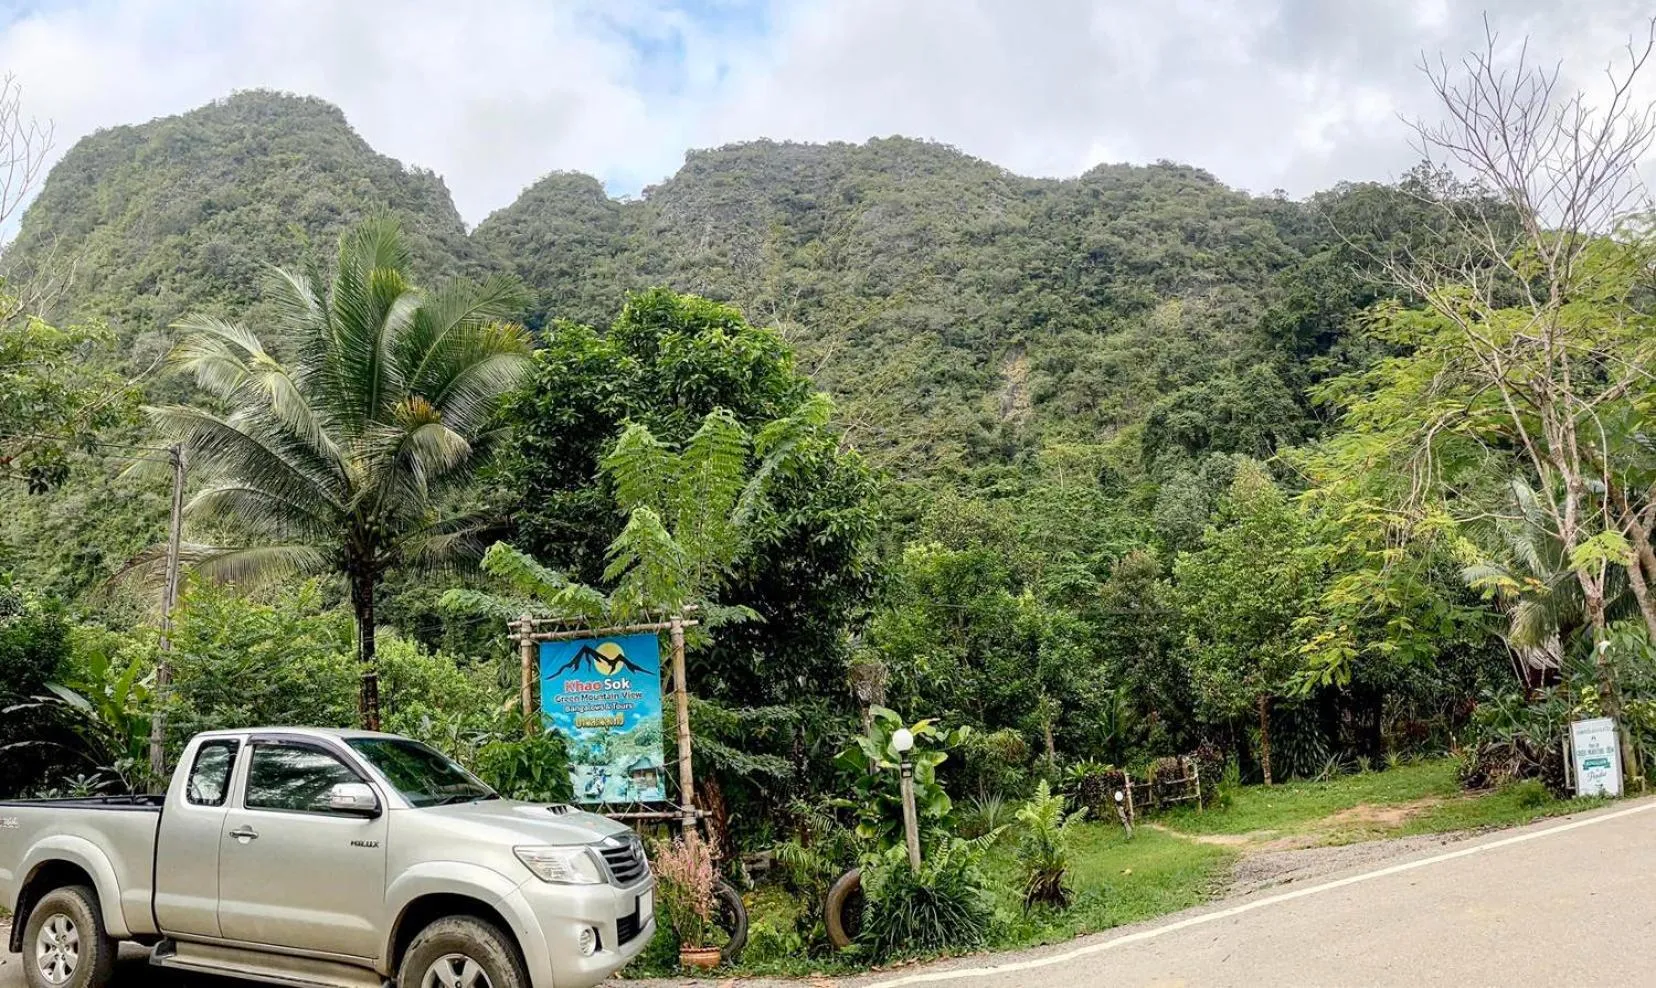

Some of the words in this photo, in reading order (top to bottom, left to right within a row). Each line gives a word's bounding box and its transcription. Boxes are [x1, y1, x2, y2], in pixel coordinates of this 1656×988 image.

[564, 680, 602, 693] Khao
[604, 678, 631, 690] Sok
[555, 693, 580, 703] Green
[581, 691, 620, 702] Mountain
[622, 689, 643, 699] View
[612, 702, 634, 710] Tours
[350, 840, 380, 848] HILUX
